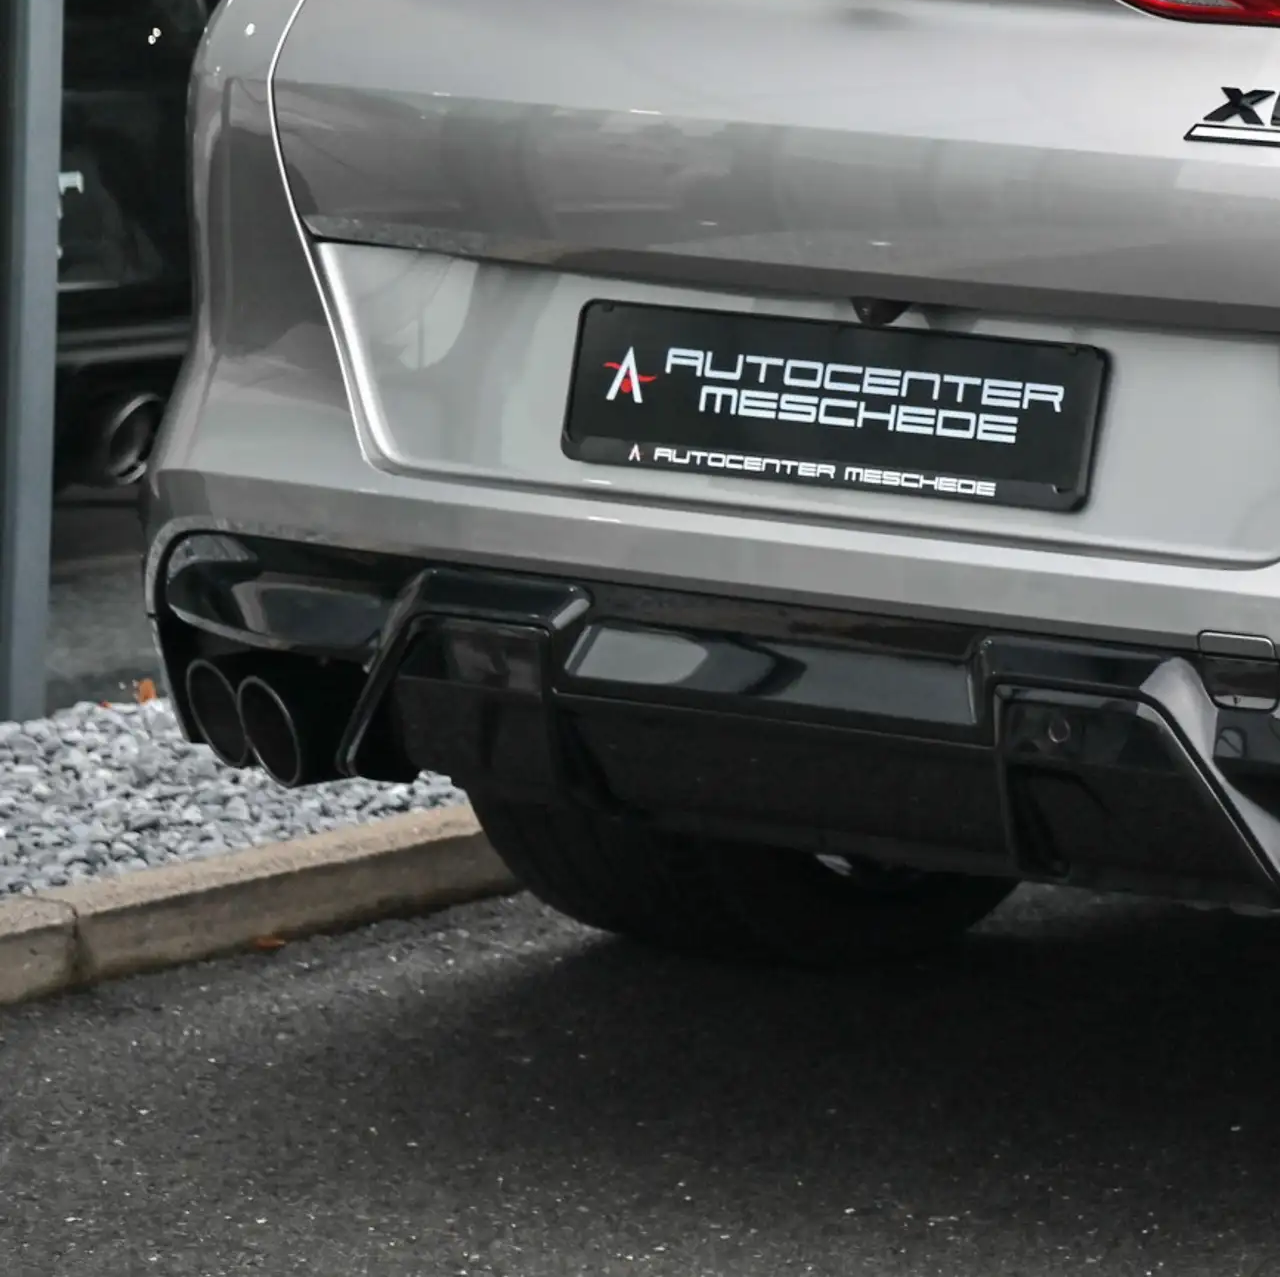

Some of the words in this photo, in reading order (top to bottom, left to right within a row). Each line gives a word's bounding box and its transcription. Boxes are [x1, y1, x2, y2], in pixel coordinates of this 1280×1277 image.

[665, 348, 1064, 412] AUTOCENTER
[699, 385, 1018, 443] MESCHEDE
[654, 447, 836, 479] AUTOCENTER
[844, 467, 996, 497] MESCHEDE
